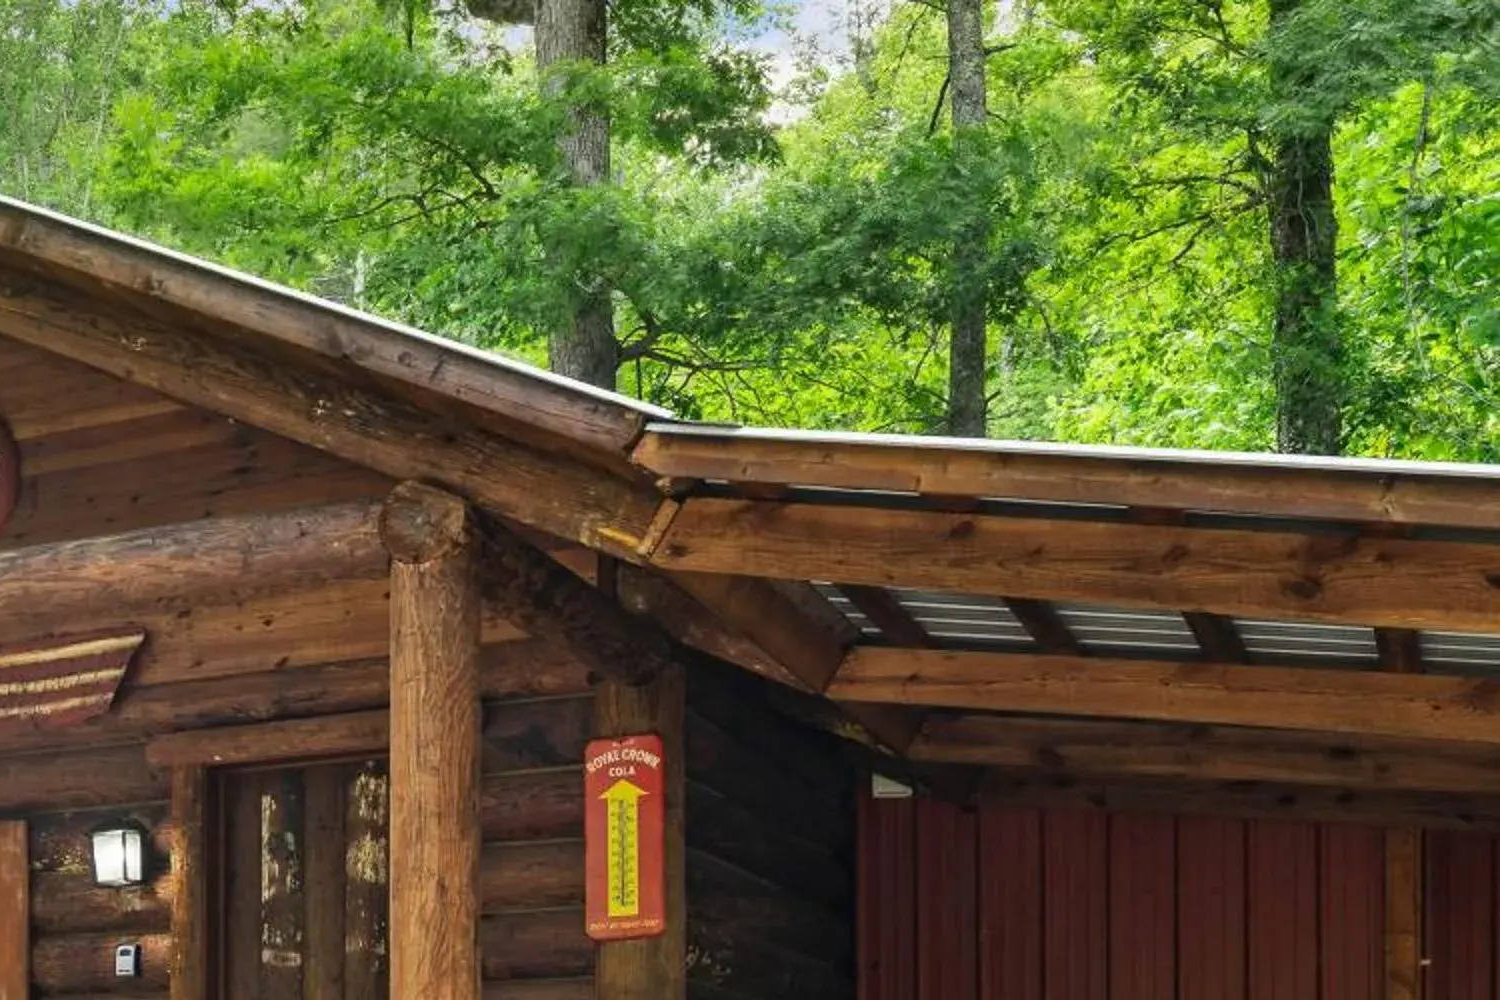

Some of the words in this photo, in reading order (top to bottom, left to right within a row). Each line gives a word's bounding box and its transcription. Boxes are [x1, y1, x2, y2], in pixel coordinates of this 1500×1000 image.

[586, 750, 620, 773] ROYAL
[622, 748, 660, 769] CROWN
[609, 765, 636, 777] COLA
